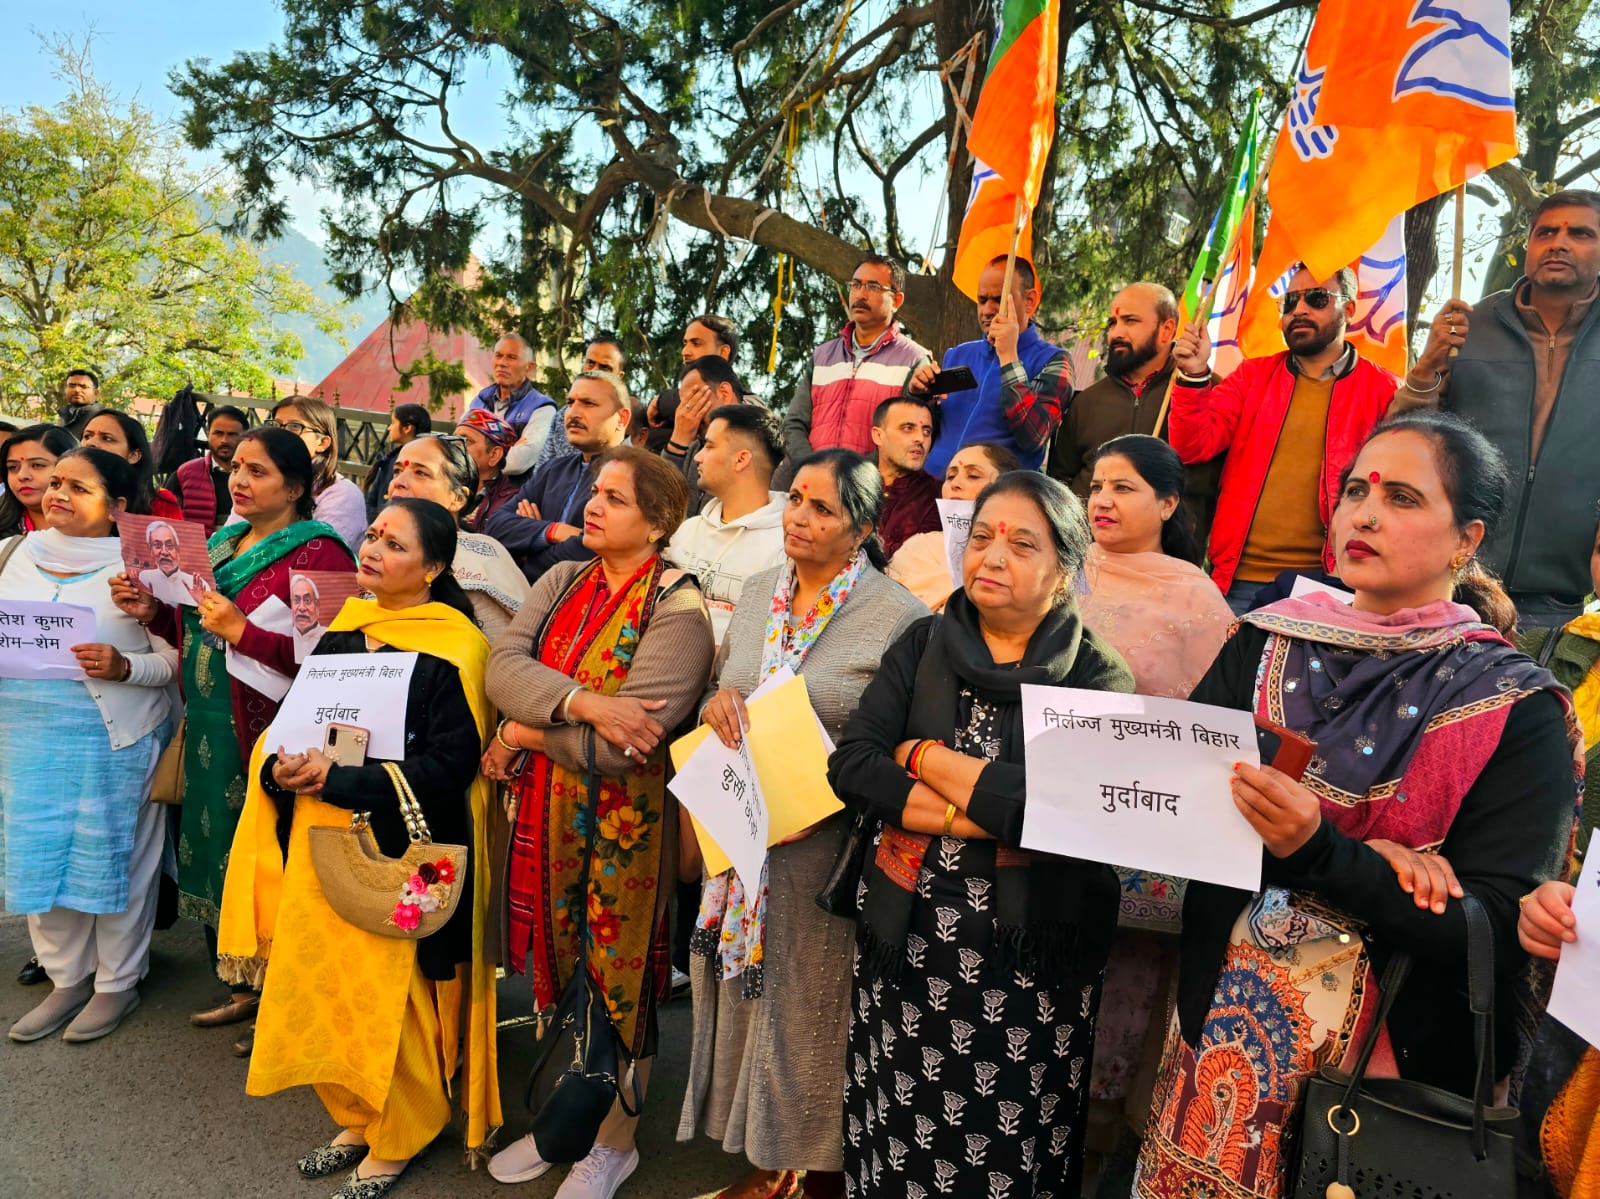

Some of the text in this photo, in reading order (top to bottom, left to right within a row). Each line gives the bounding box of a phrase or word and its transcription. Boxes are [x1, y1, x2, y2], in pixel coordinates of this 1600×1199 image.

[947, 513, 971, 530] महिल
[33, 615, 74, 631] कुमार
[306, 665, 404, 681] निर्लज्ज मुख्यमंत्री बिहार
[314, 703, 360, 724] मुर्दाबाद
[1043, 707, 1240, 750] निर्लज्ज मुख्यमंत्री बिहार
[1099, 781, 1180, 816] मुर्दाबाद
